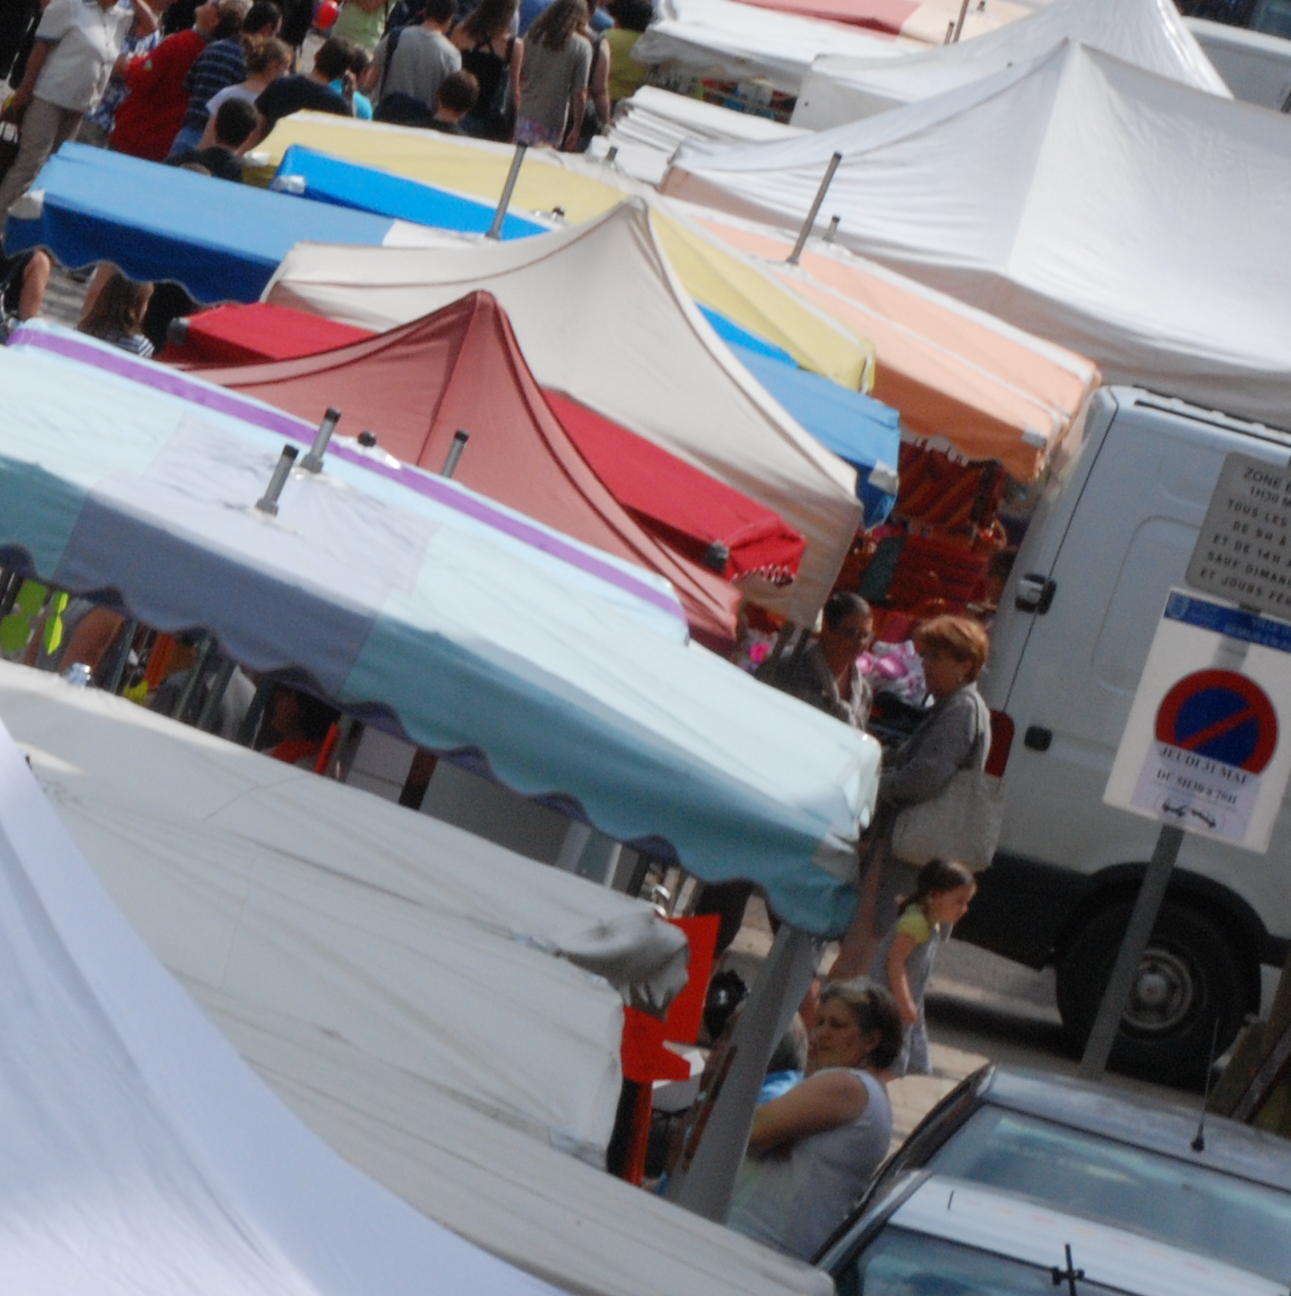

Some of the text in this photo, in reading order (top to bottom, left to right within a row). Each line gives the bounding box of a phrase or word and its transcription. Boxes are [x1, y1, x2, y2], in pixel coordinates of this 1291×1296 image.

[1243, 467, 1282, 488] ZONE
[1251, 485, 1279, 503] 1H30
[1228, 499, 1287, 528] TOUS LES
[1233, 521, 1248, 534] DE
[1208, 551, 1239, 567] SAUF
[1213, 533, 1229, 545] ET
[1234, 539, 1250, 553] DE
[1258, 547, 1281, 564] 14H
[1200, 567, 1216, 580] ET
[1222, 574, 1263, 597] JOURS
[1157, 767, 1172, 781] DE
[1160, 745, 1249, 785] JEUDI 31 MAI
